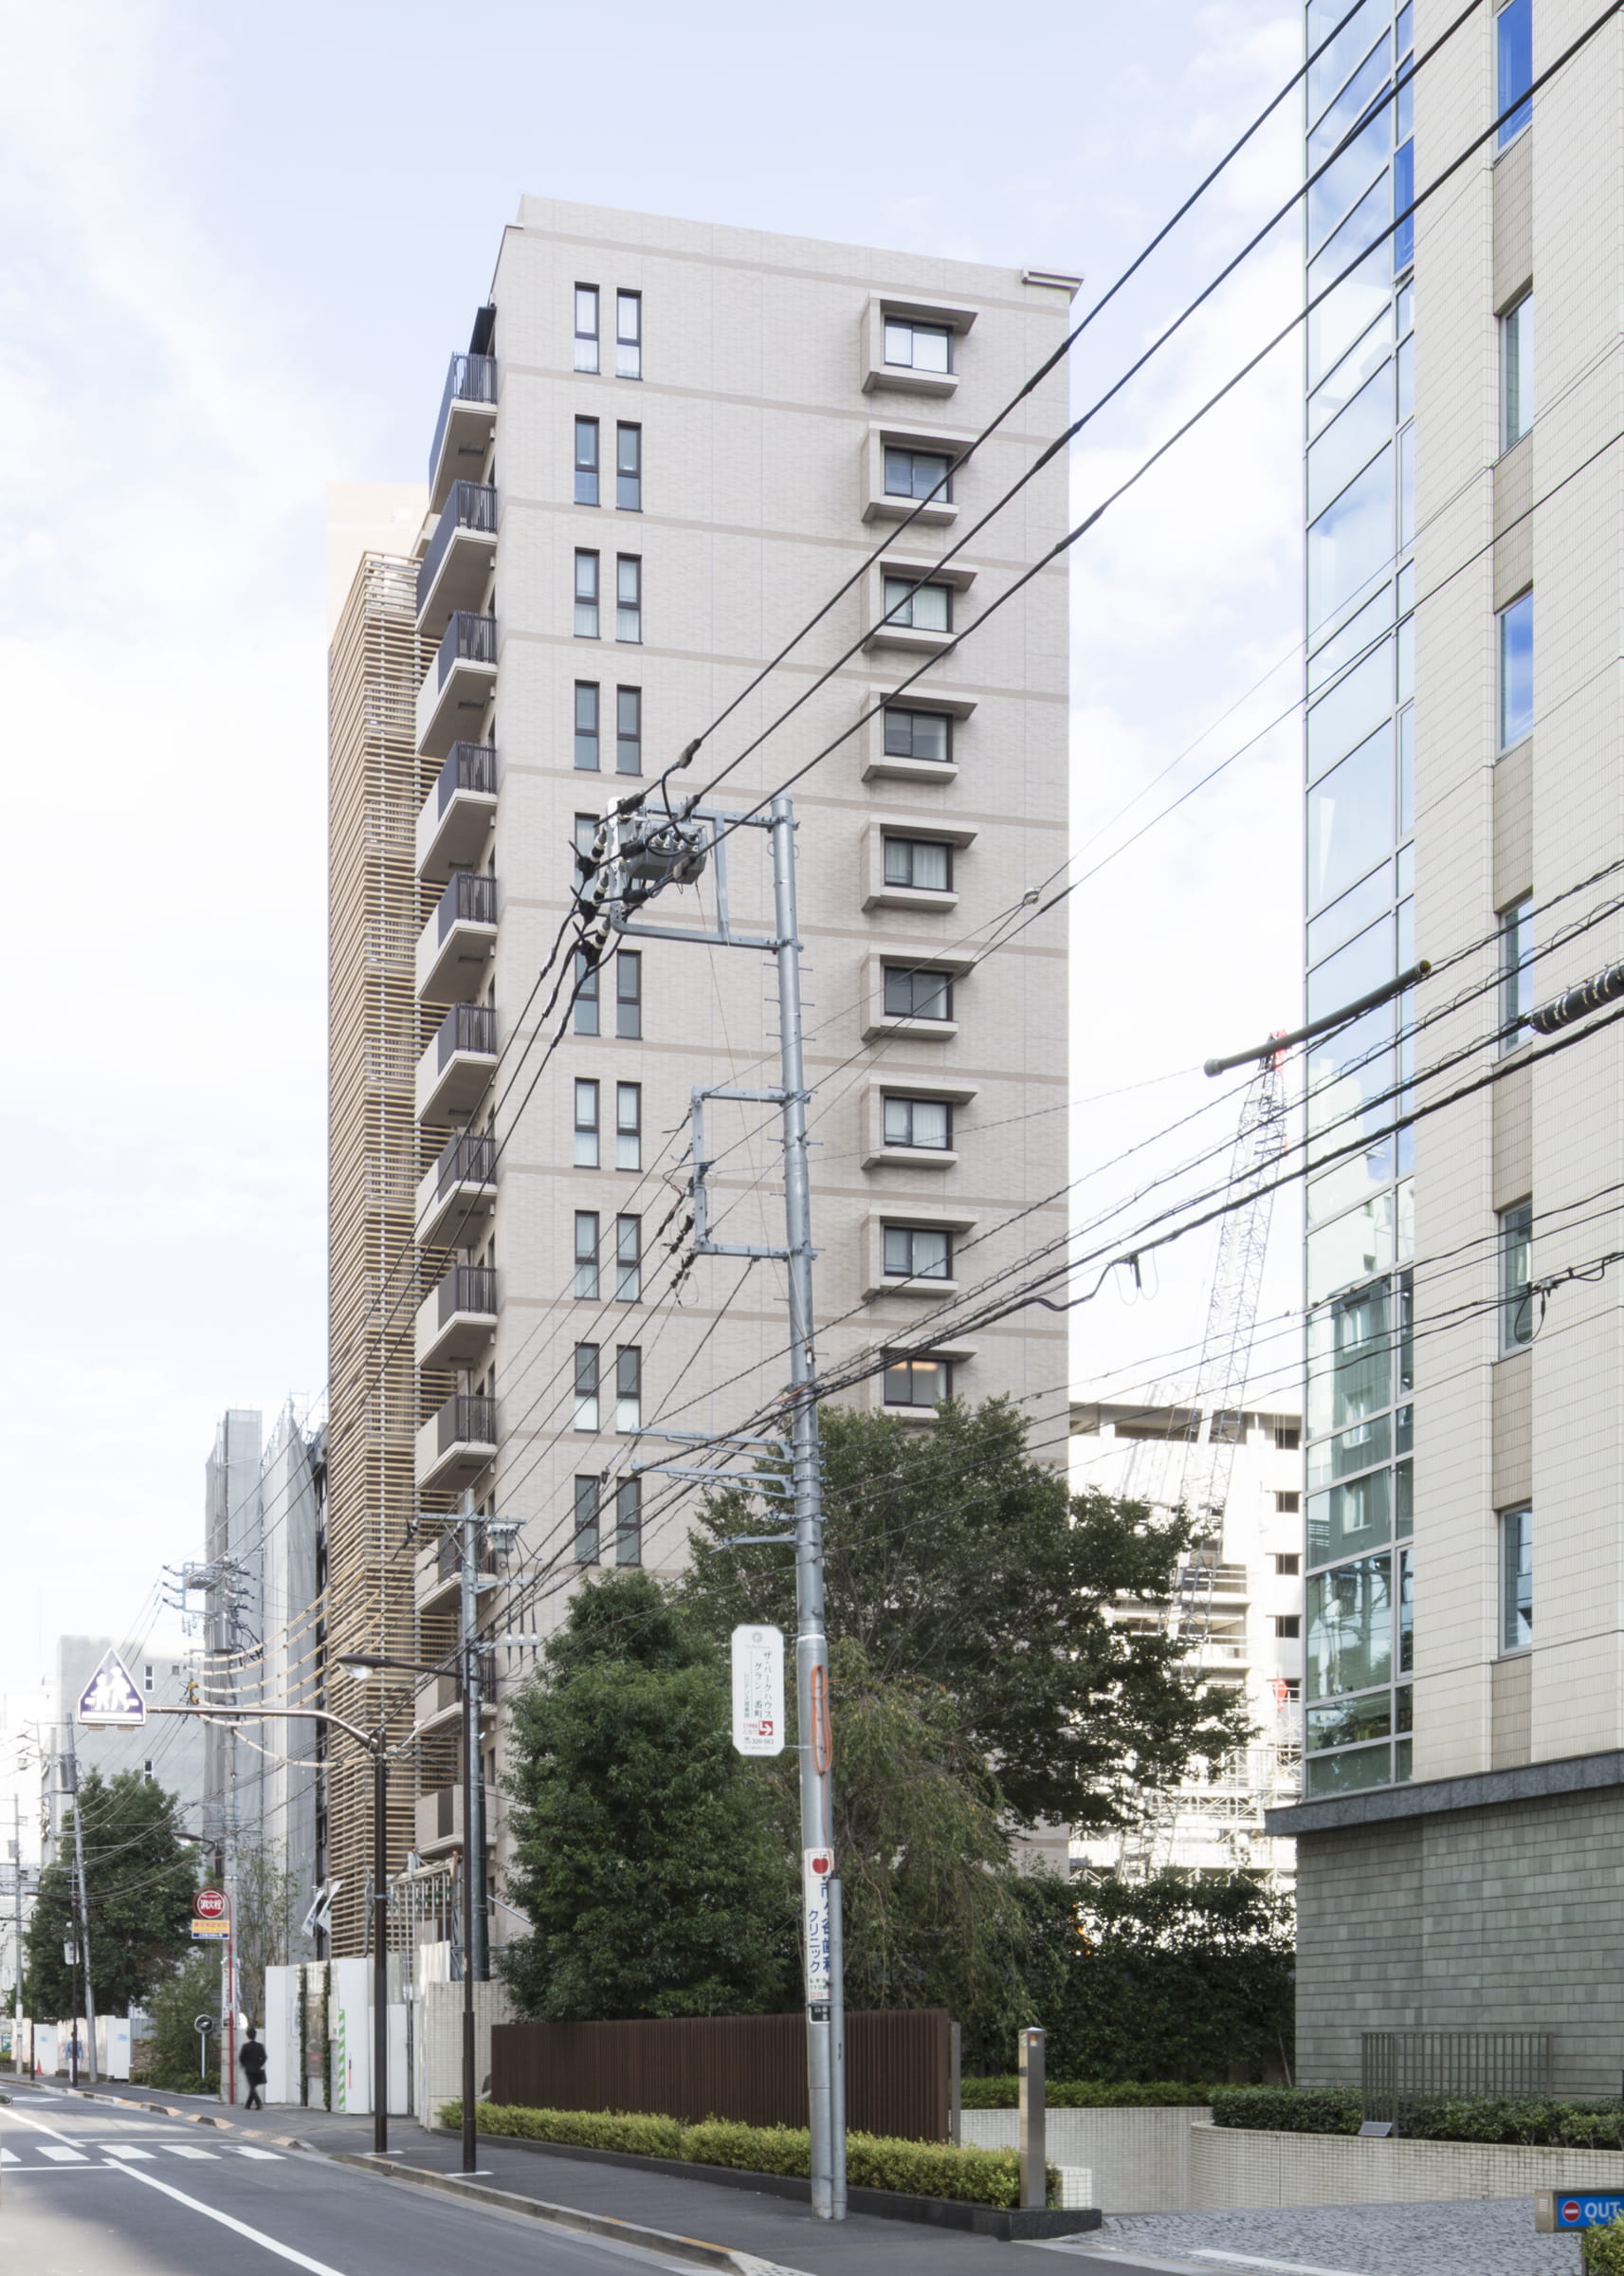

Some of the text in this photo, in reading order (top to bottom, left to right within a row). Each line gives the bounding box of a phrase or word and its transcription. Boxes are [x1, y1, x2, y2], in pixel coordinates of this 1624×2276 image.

[200, 1900, 222, 1910] 消火栓
[808, 1910, 820, 1973] クリニック
[1585, 2202, 1620, 2219] OUT
